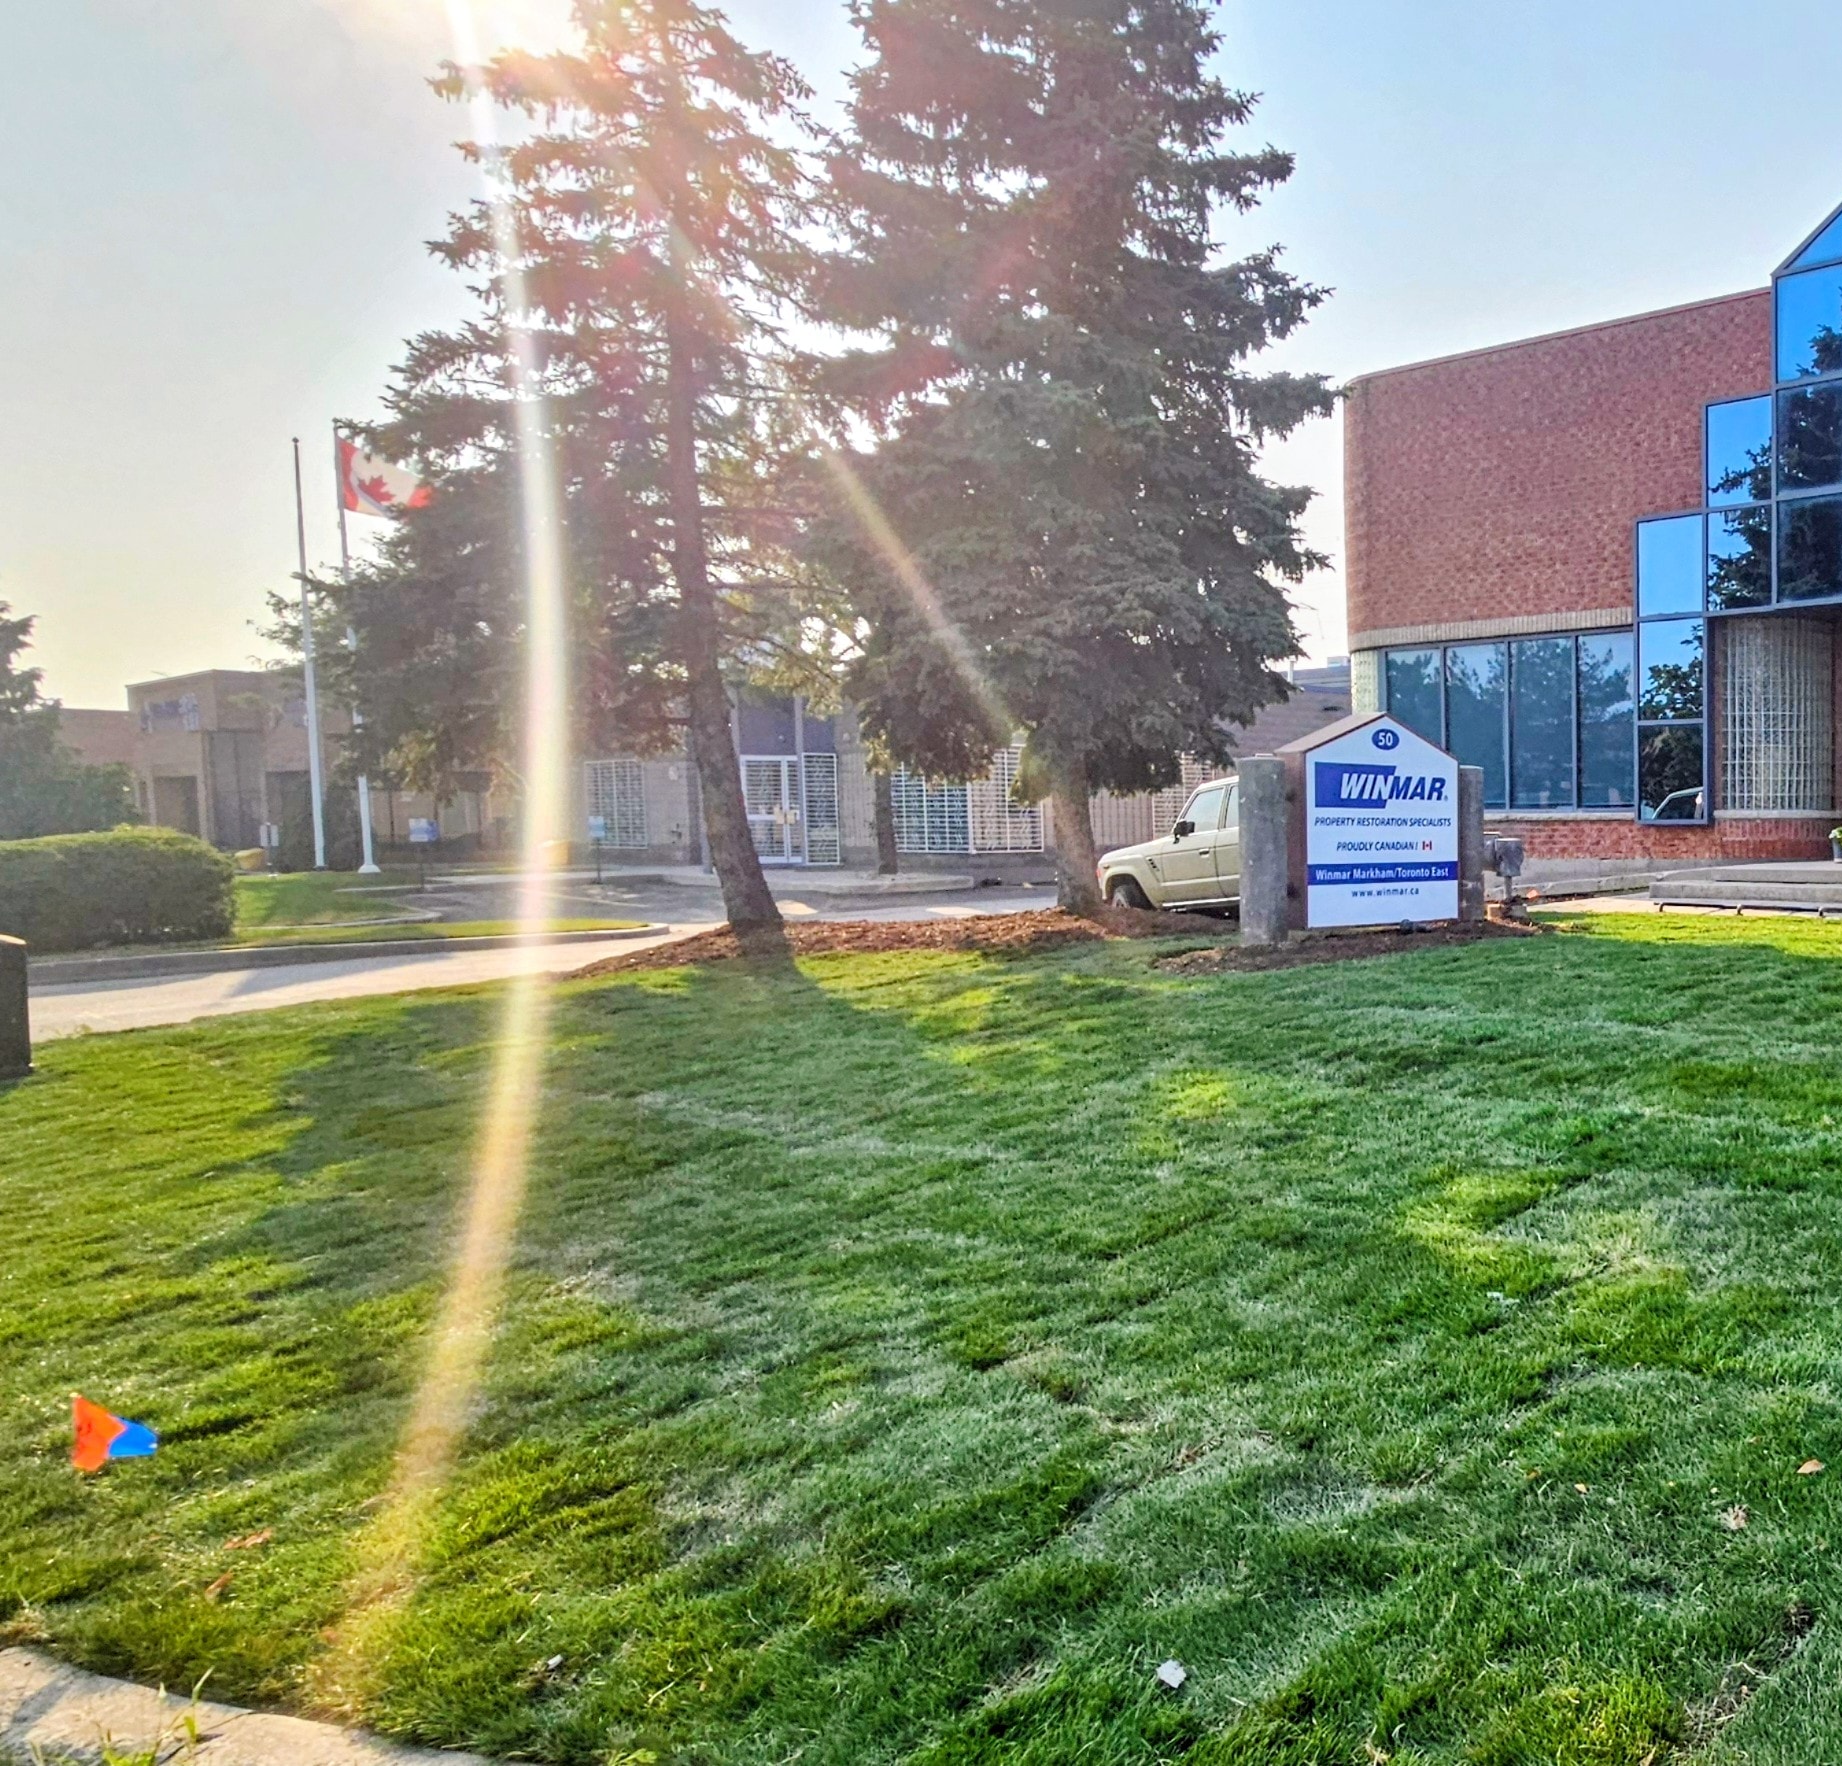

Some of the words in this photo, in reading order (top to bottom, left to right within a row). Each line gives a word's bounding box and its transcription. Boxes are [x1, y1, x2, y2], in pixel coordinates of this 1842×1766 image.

[1378, 732, 1393, 746] 50
[1340, 773, 1446, 801] WINMAR
[1314, 816, 1355, 827] PROPERTY
[1356, 817, 1408, 827] RESTORATION
[1409, 818, 1451, 827] SPECIALISTS
[1336, 841, 1373, 851] PROUDLY
[1315, 869, 1350, 880] Winmar
[1352, 867, 1429, 879] Markham/Toronto
[1431, 867, 1449, 877] East
[1352, 887, 1419, 897] www.winmar.ca
